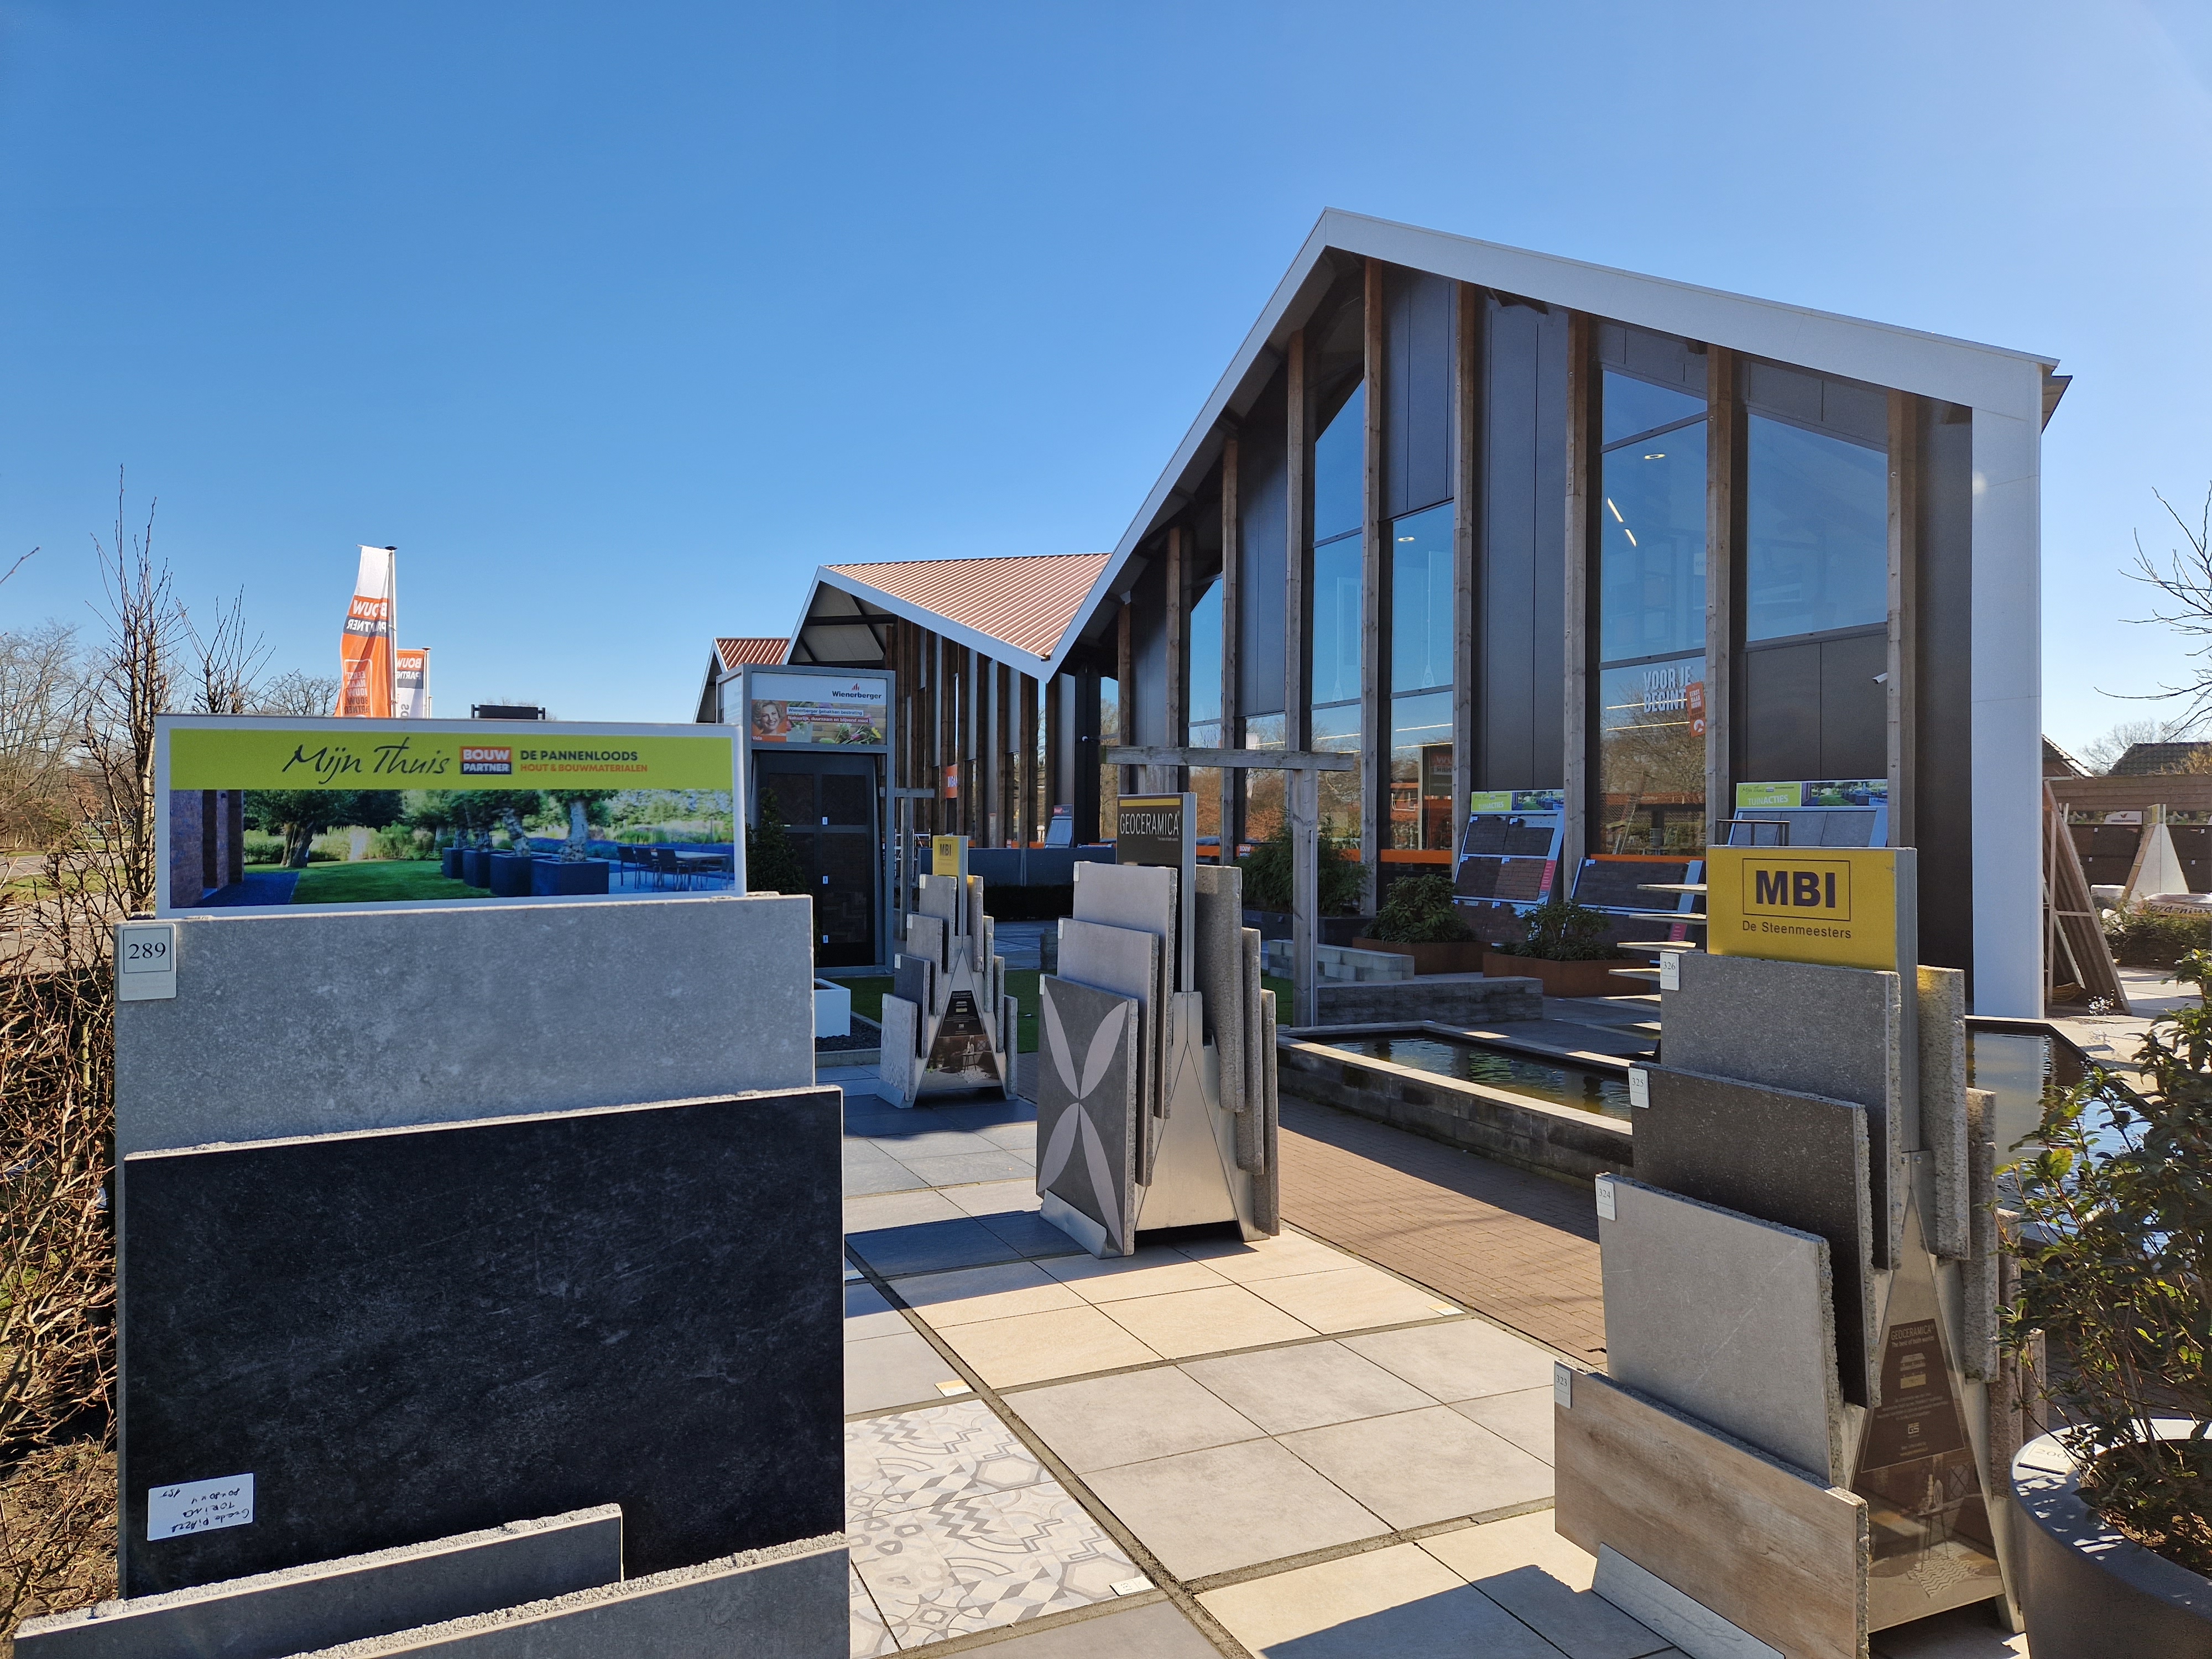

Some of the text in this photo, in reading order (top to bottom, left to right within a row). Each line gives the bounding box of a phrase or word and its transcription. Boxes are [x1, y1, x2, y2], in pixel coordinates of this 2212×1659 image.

[1643, 666, 1691, 691] VOOR JE
[832, 690, 882, 700] Wienerberger
[1644, 689, 1687, 713] BEGINT
[281, 736, 450, 784] Mijn Thuis
[463, 749, 509, 760] BOUW
[520, 750, 638, 761] DE PANNENLOODS
[463, 763, 509, 772] PARTNER
[520, 764, 549, 772] HOUT
[551, 764, 556, 772] &
[1478, 801, 1504, 810] TUINACTIES
[1747, 795, 1788, 806] TUINACTIES
[1120, 813, 1179, 836] GEOCERAMICA
[940, 843, 951, 856] MBI
[1756, 870, 1835, 908] MBI
[1743, 921, 1851, 939] De Steenmeesters
[128, 942, 166, 959] 289
[1663, 961, 1676, 971] 326
[1632, 1077, 1644, 1087] 325
[1599, 1188, 1611, 1199] 324
[1556, 1374, 1567, 1387] 323
